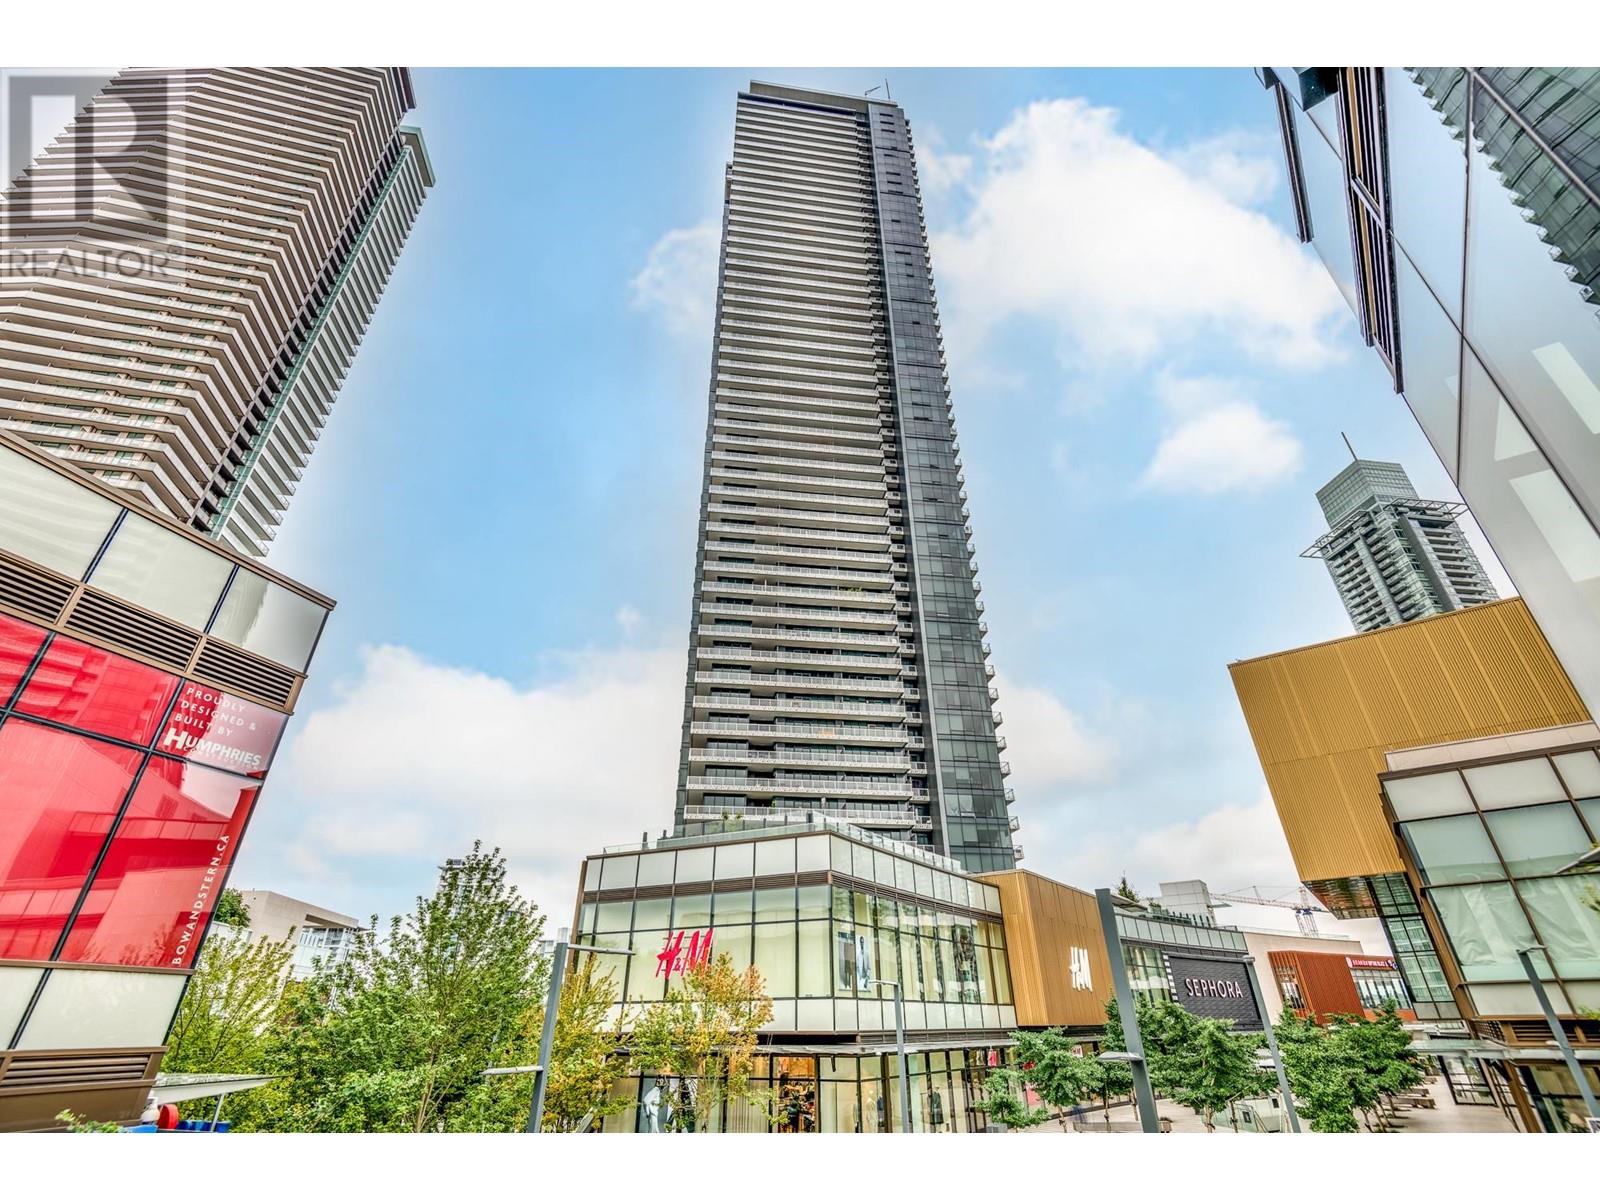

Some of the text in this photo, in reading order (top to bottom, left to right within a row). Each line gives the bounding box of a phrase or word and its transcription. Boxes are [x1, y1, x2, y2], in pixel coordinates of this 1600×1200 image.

[186, 687, 246, 712] PROUDLY
[174, 713, 233, 737] BUILT BY
[180, 700, 257, 731] DESIGNED &
[172, 835, 230, 965] BOWANDSTERN.CA
[656, 928, 714, 979] H&M
[1185, 978, 1244, 999] SEPHORA
